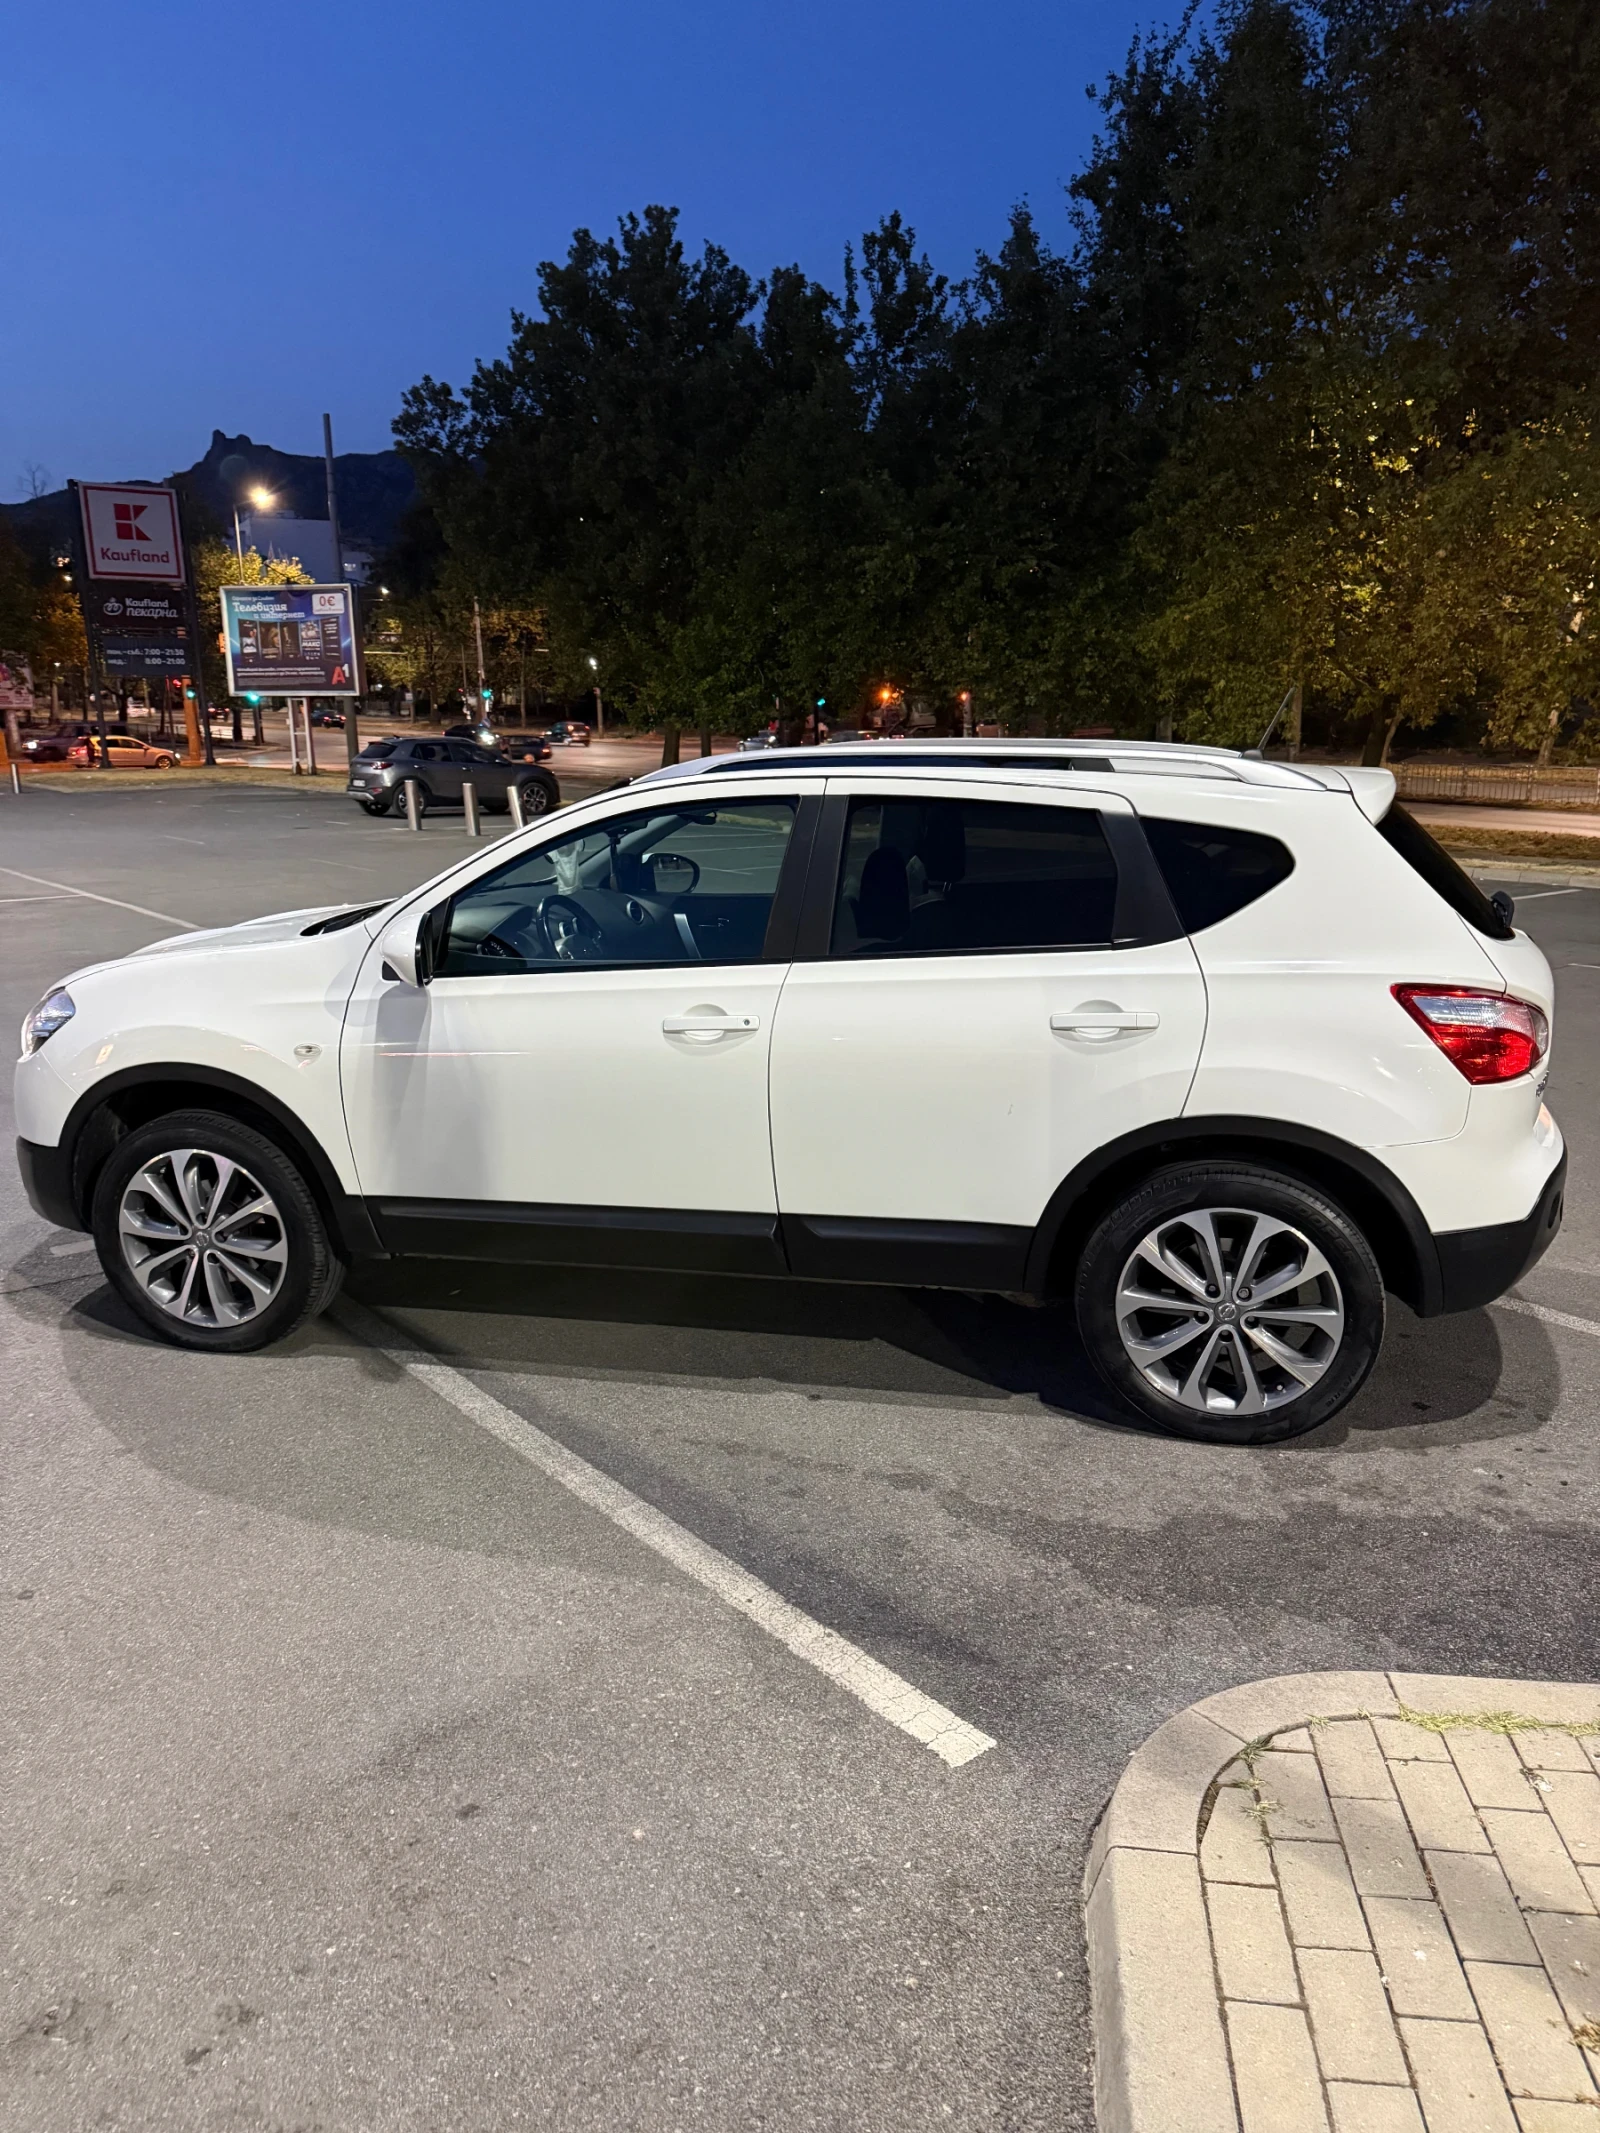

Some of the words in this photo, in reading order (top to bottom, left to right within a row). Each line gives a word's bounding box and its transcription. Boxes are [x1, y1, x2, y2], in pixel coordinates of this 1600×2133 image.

[100, 547, 170, 564] Kaufland
[125, 597, 169, 608] Kaufland
[319, 595, 336, 607] 0€
[126, 607, 178, 619] пекарна
[232, 601, 288, 614] Телевизия
[331, 663, 350, 685] A1
